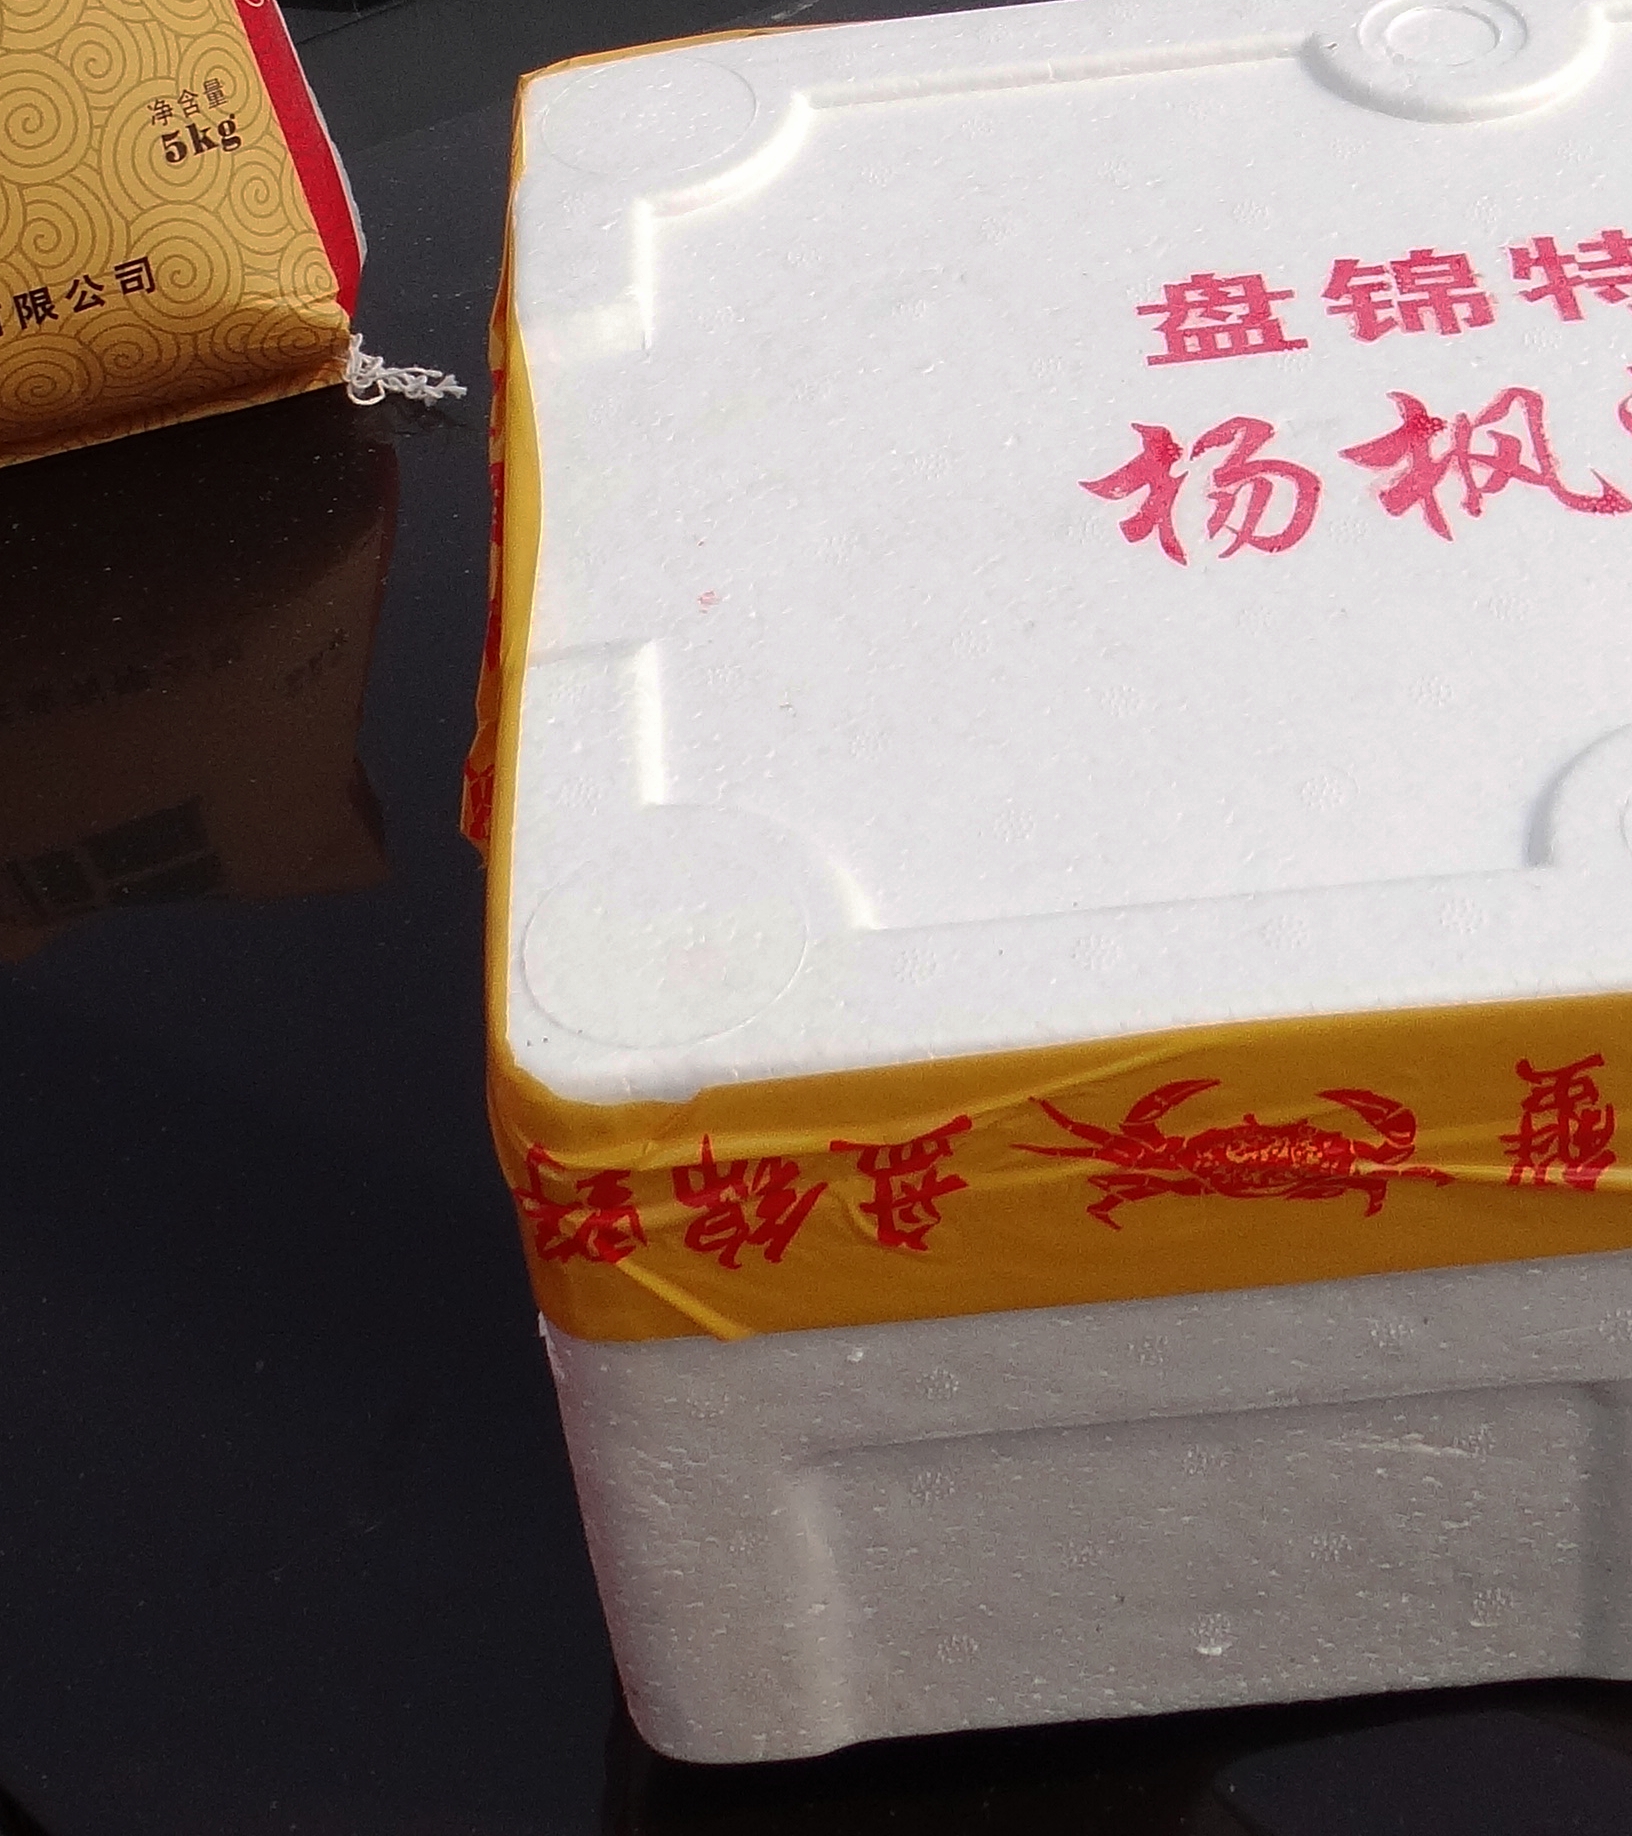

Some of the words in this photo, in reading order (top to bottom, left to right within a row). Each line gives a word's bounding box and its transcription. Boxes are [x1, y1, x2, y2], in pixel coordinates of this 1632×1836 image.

[147, 77, 229, 127] 净含量
[161, 113, 242, 163] 5kg
